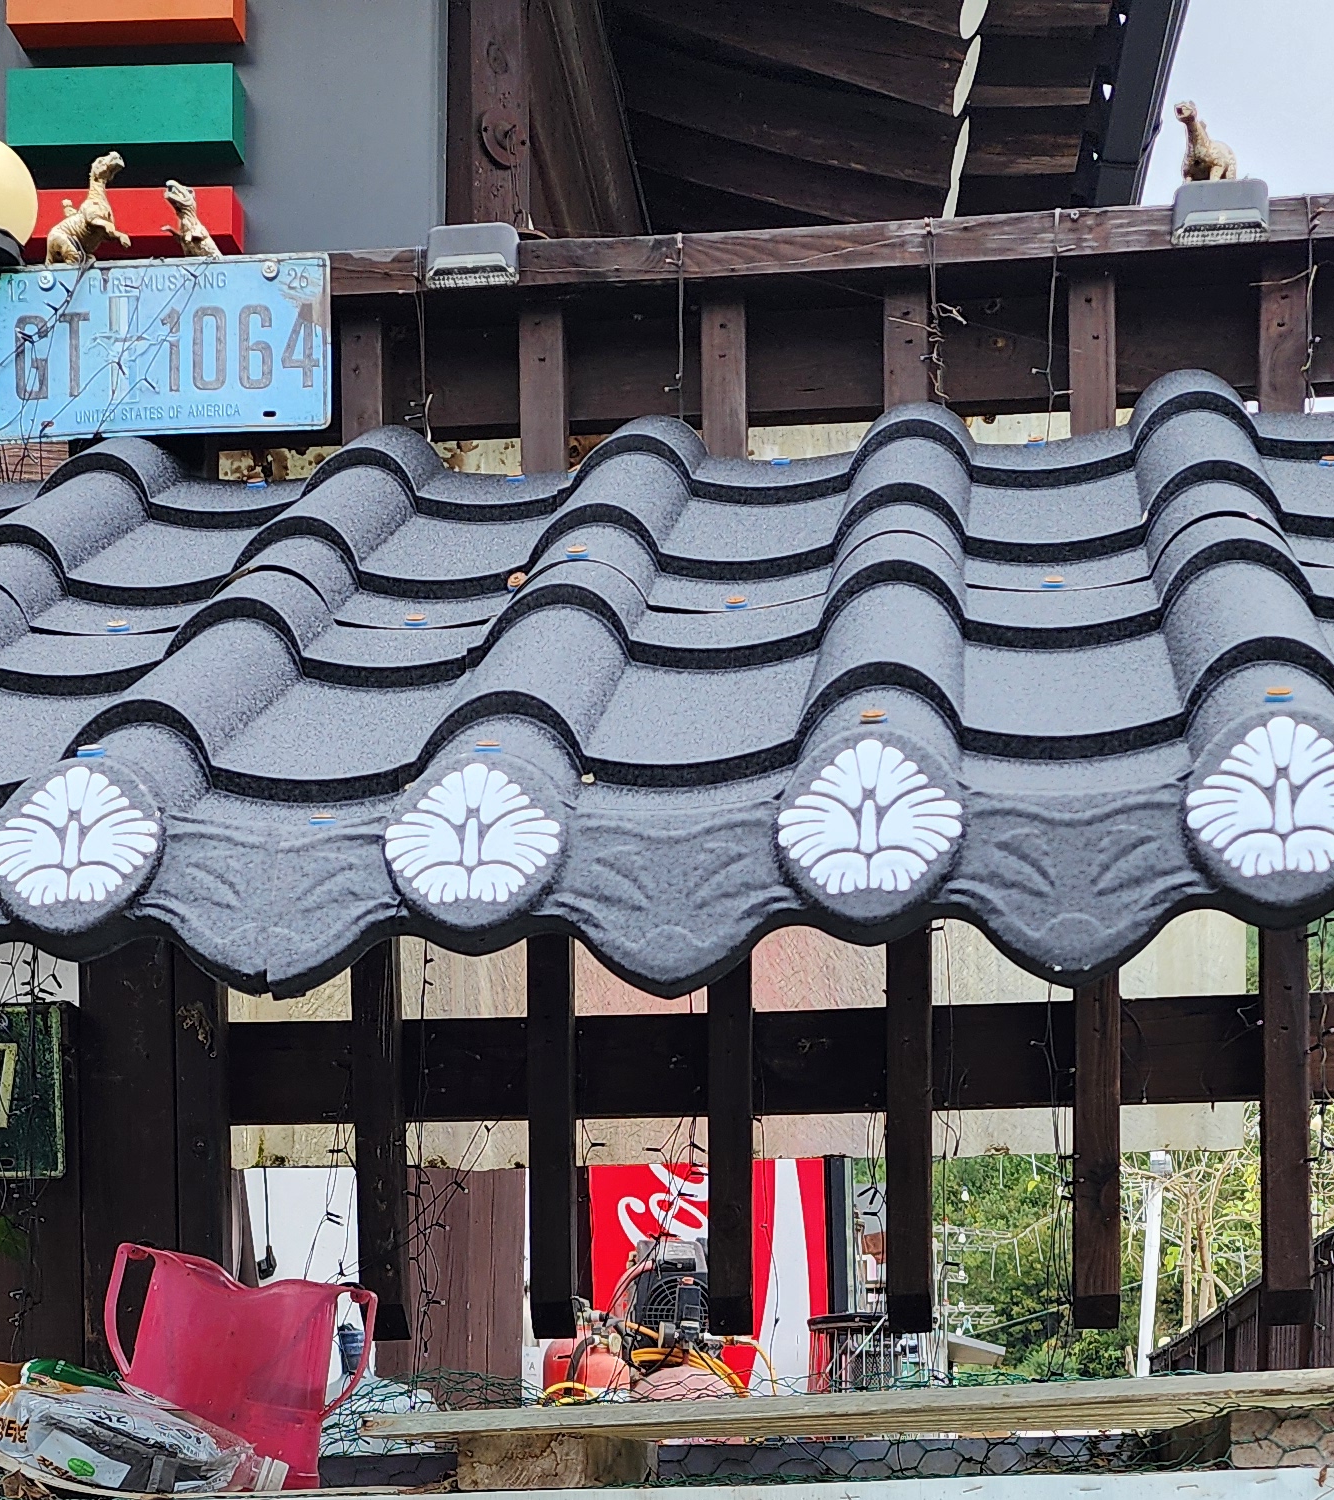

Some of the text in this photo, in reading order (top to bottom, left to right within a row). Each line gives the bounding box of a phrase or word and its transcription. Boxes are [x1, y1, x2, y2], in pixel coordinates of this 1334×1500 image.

[7, 267, 310, 303] 12 FORD MUSTANG 26
[15, 303, 320, 401] GT 1064
[75, 403, 242, 425] UNITED STATES OF AMERICA
